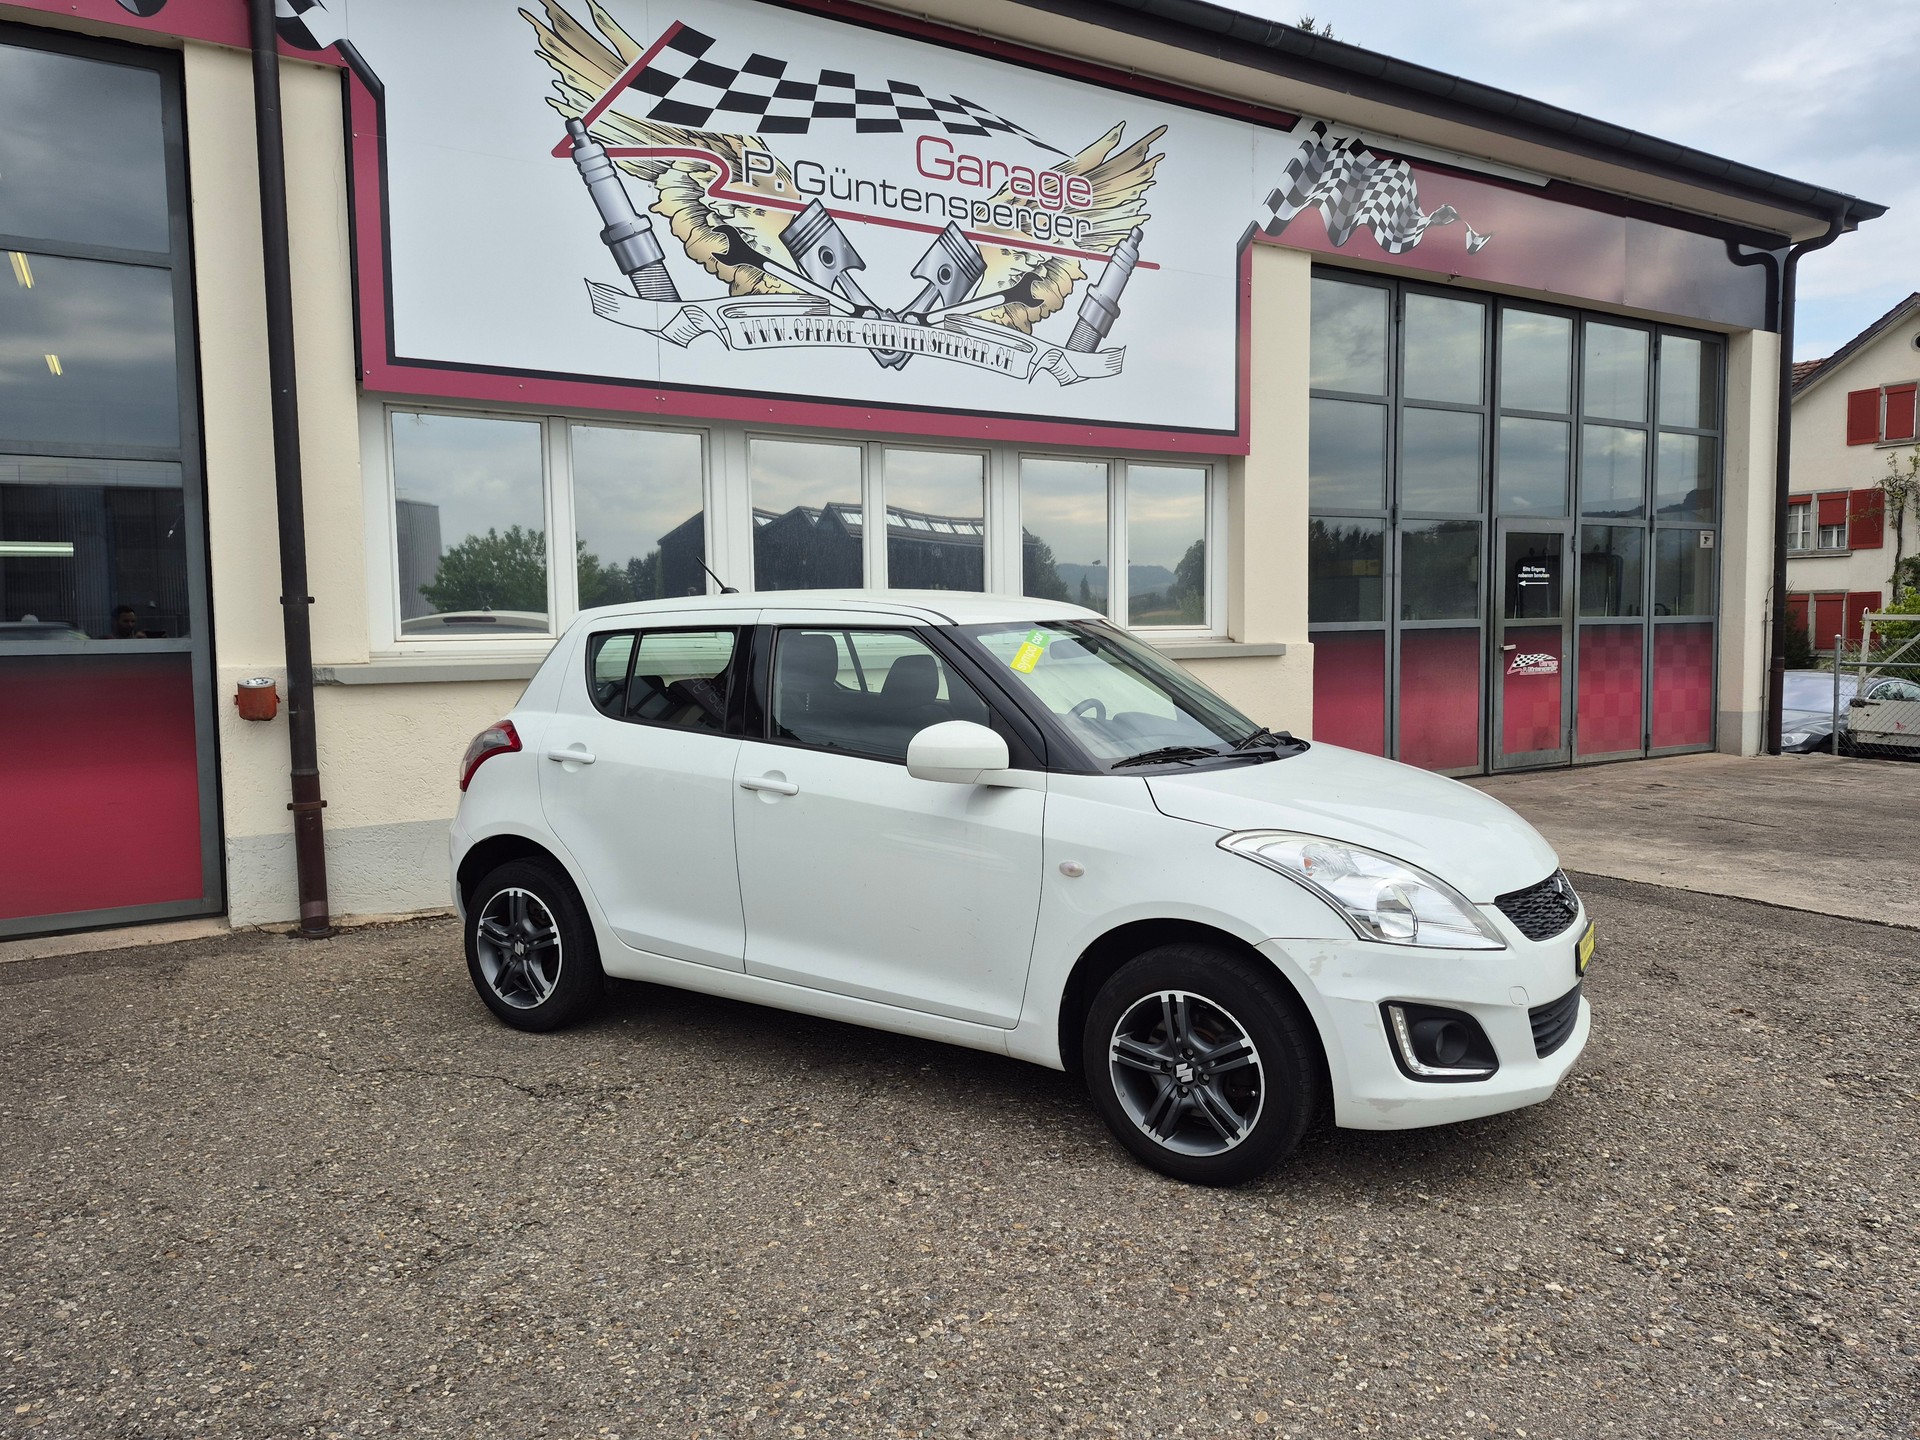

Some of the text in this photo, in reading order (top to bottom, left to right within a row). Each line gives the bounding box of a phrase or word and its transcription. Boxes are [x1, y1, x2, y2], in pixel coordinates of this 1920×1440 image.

[744, 150, 1092, 241] P. Güntensperger
[916, 134, 1092, 211] Garage
